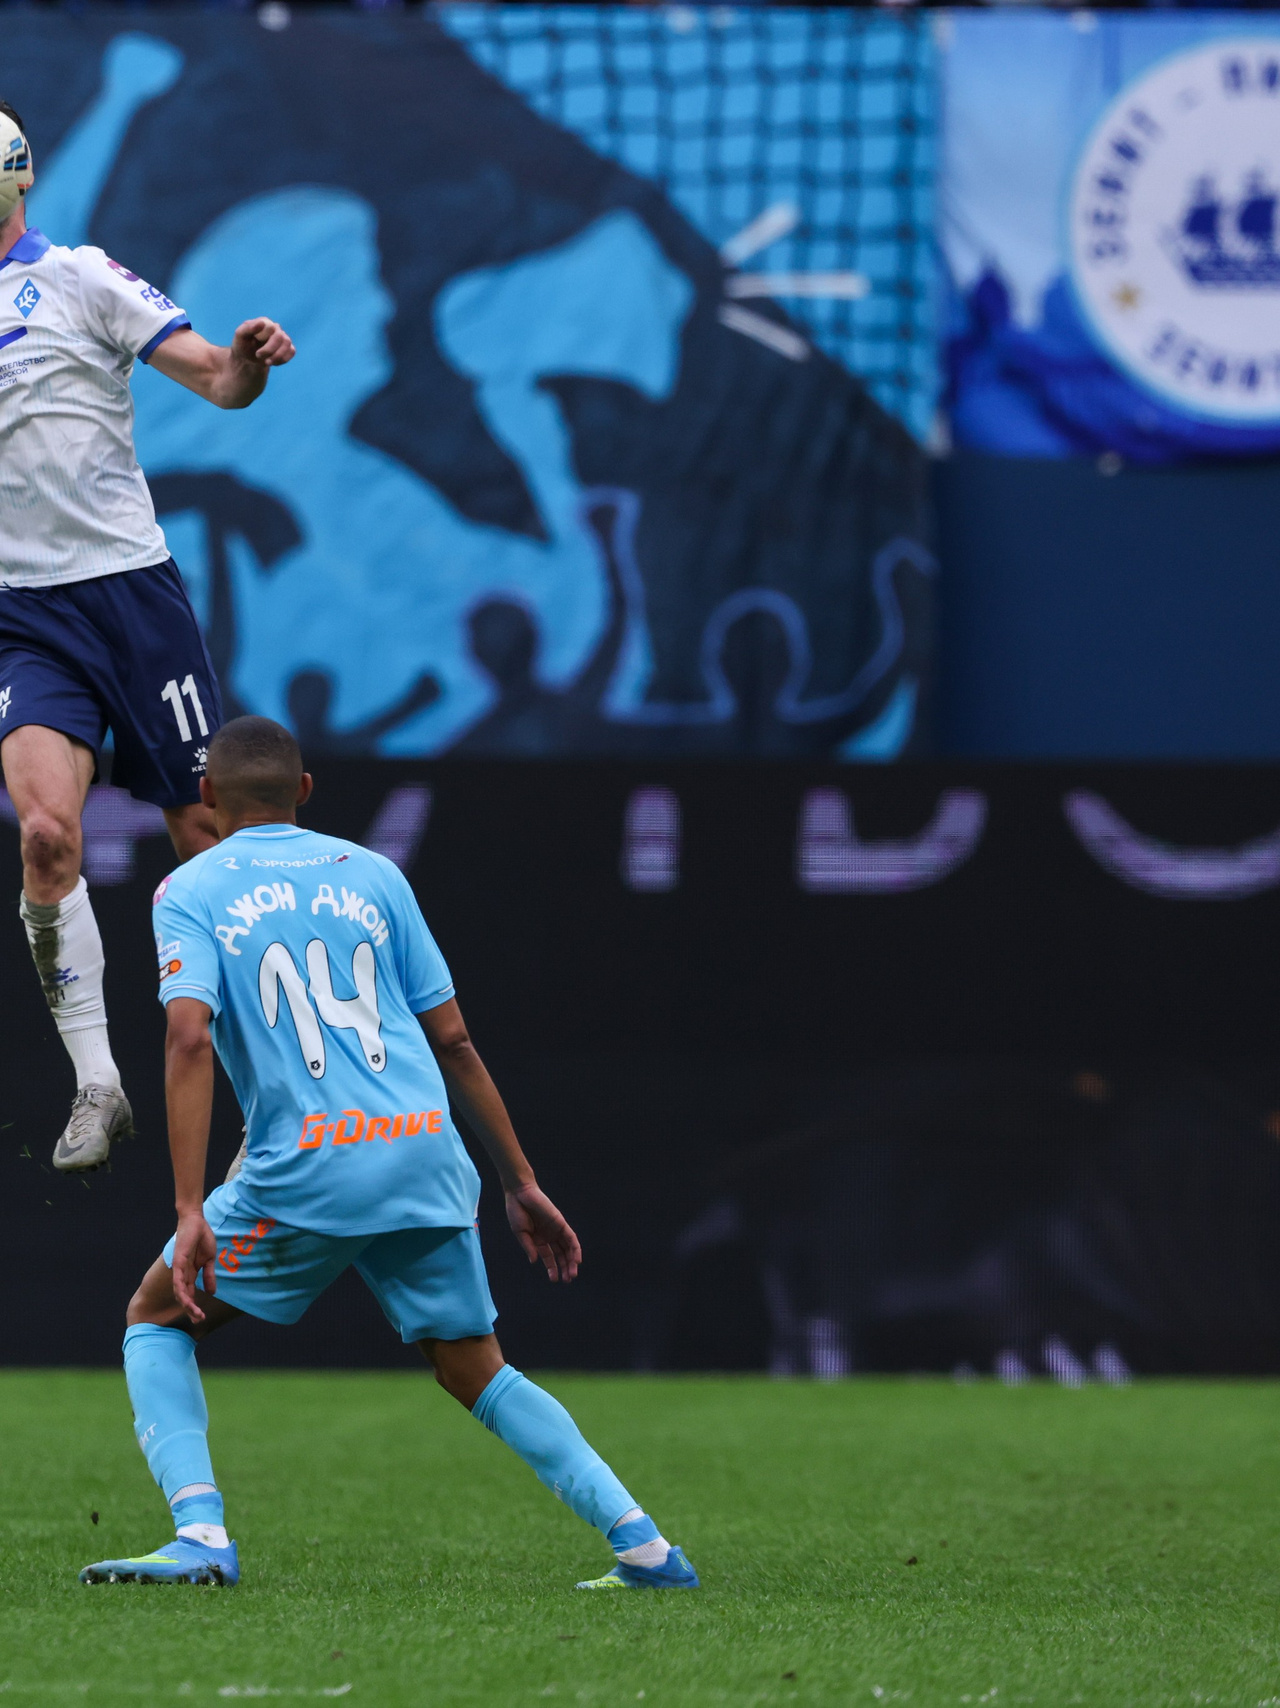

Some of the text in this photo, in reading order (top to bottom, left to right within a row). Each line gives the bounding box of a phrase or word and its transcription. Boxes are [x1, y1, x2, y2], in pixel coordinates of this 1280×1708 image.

[161, 674, 209, 743] 11
[250, 854, 332, 869] АЭРОФЛОТ
[215, 882, 296, 956] ДЖОН
[311, 884, 389, 947] ДЖОН
[258, 938, 387, 1079] 14
